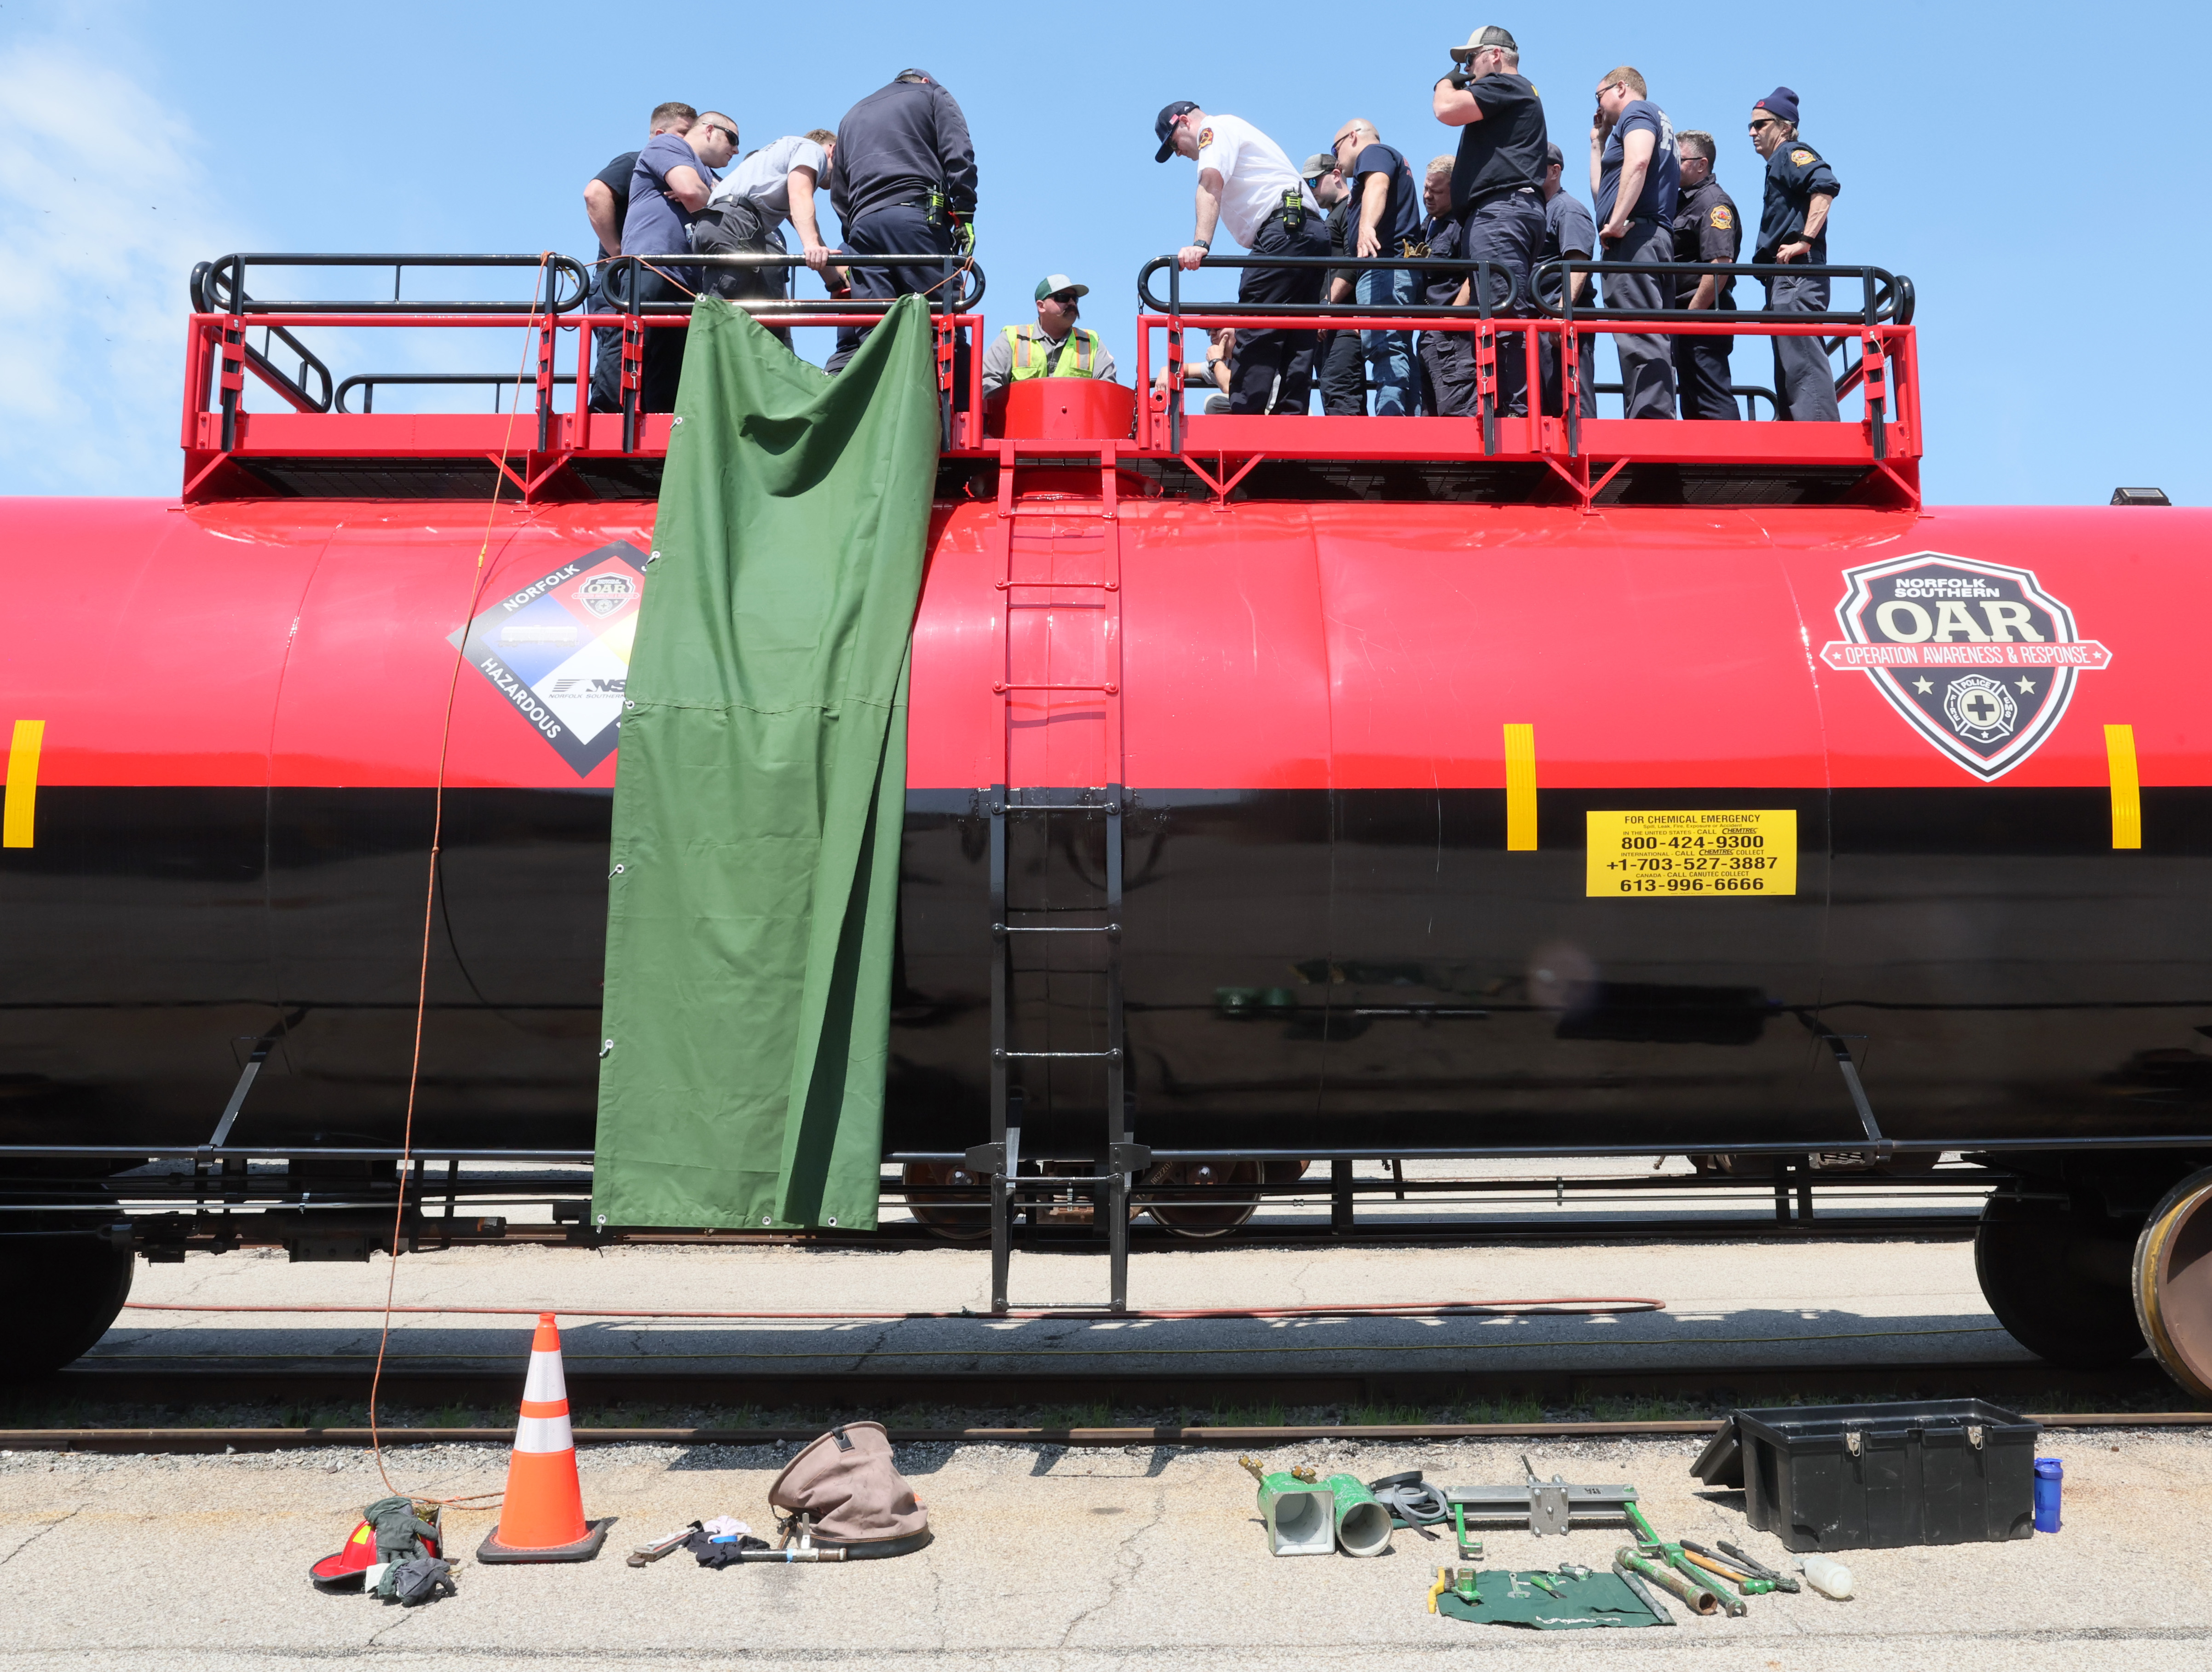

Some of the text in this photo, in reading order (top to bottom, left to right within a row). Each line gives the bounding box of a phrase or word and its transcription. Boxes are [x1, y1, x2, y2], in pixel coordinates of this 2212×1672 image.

[502, 564, 580, 611] NORFOLK
[588, 584, 626, 593] OAR
[1896, 579, 1986, 588] NORFOLK
[1895, 588, 2000, 597] SOUTHERN
[1876, 600, 2045, 643] OAR
[1845, 646, 2091, 664] OPERATION AWARENESS & RESPONSE
[1961, 679, 1991, 689] POLICE
[480, 657, 561, 738] HAZARDOUS
[1950, 694, 1961, 721] FIRE
[2003, 697, 2013, 718] EMS
[1622, 836, 1763, 849] 800-424-9300
[1607, 857, 1777, 871] +1-703-527-3887
[1621, 878, 1763, 891] 613-996-6666
